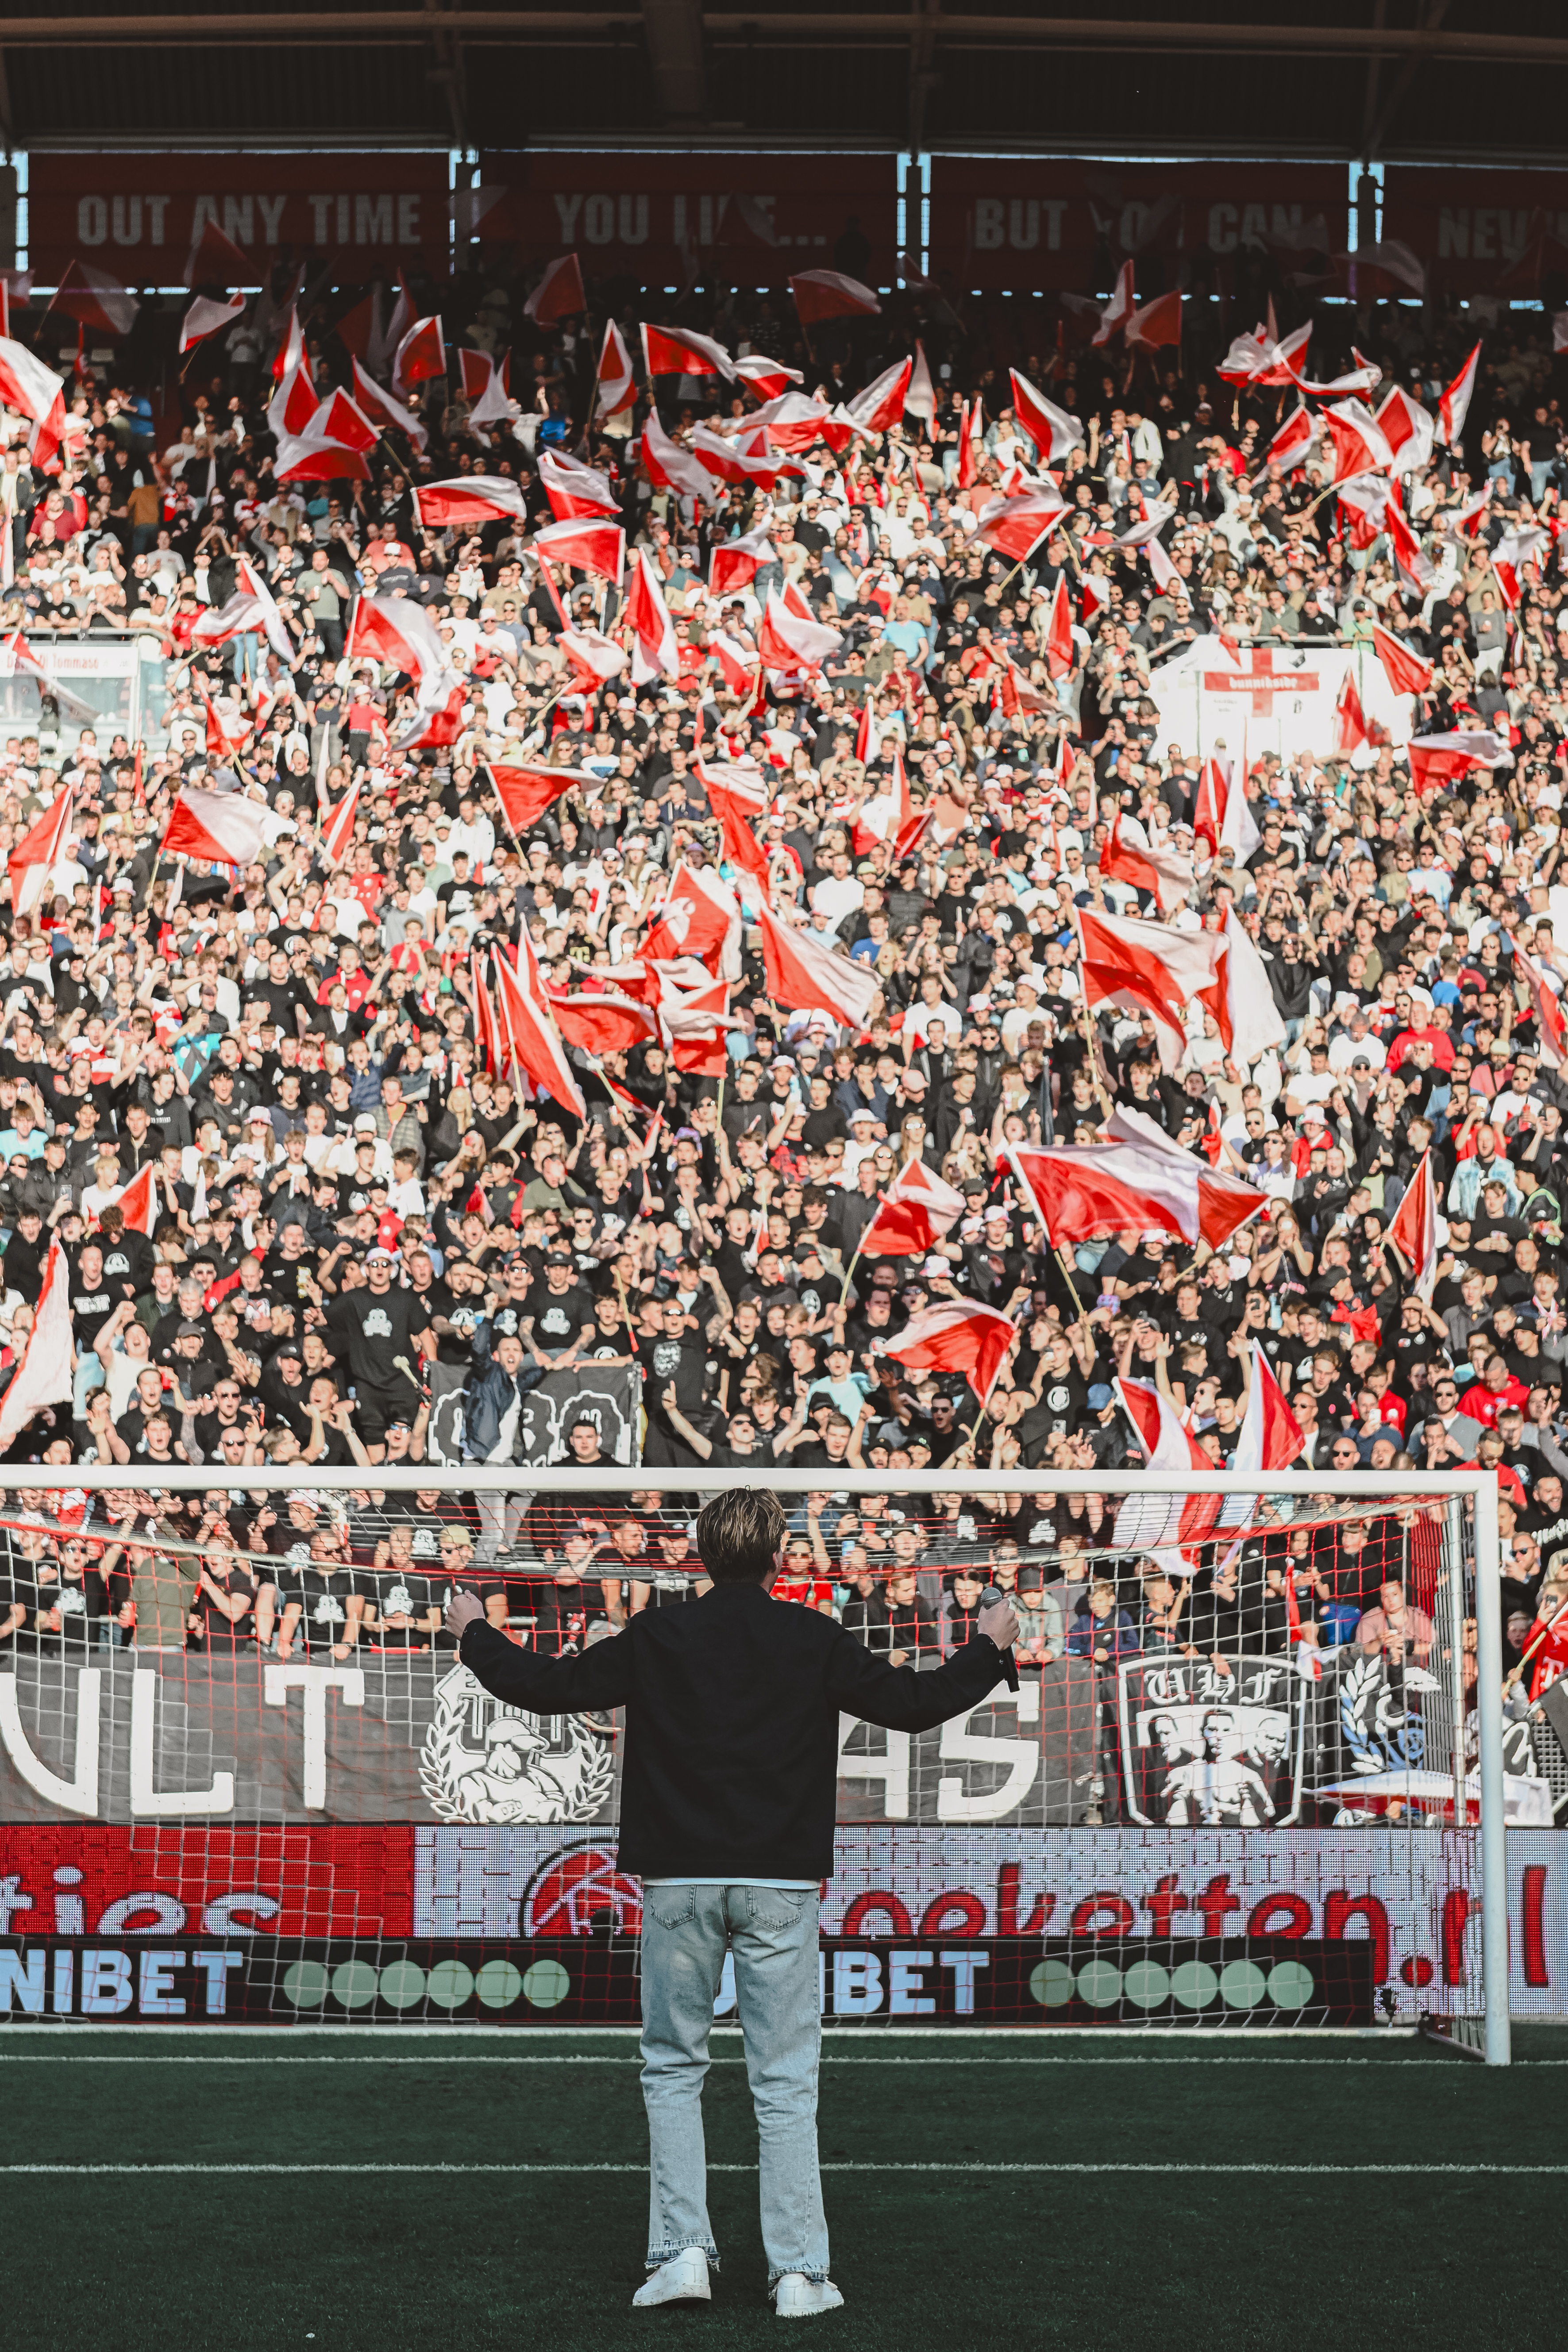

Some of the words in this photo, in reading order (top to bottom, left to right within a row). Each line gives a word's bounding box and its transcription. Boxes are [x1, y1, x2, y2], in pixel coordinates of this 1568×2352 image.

[77, 194, 170, 245] OUT
[191, 194, 287, 245] ANY
[308, 194, 421, 245] TIME
[554, 194, 649, 245] YOU
[975, 199, 1067, 251] BUT
[52, 653, 99, 670] Tommaso
[0, 1665, 365, 1817] ULT
